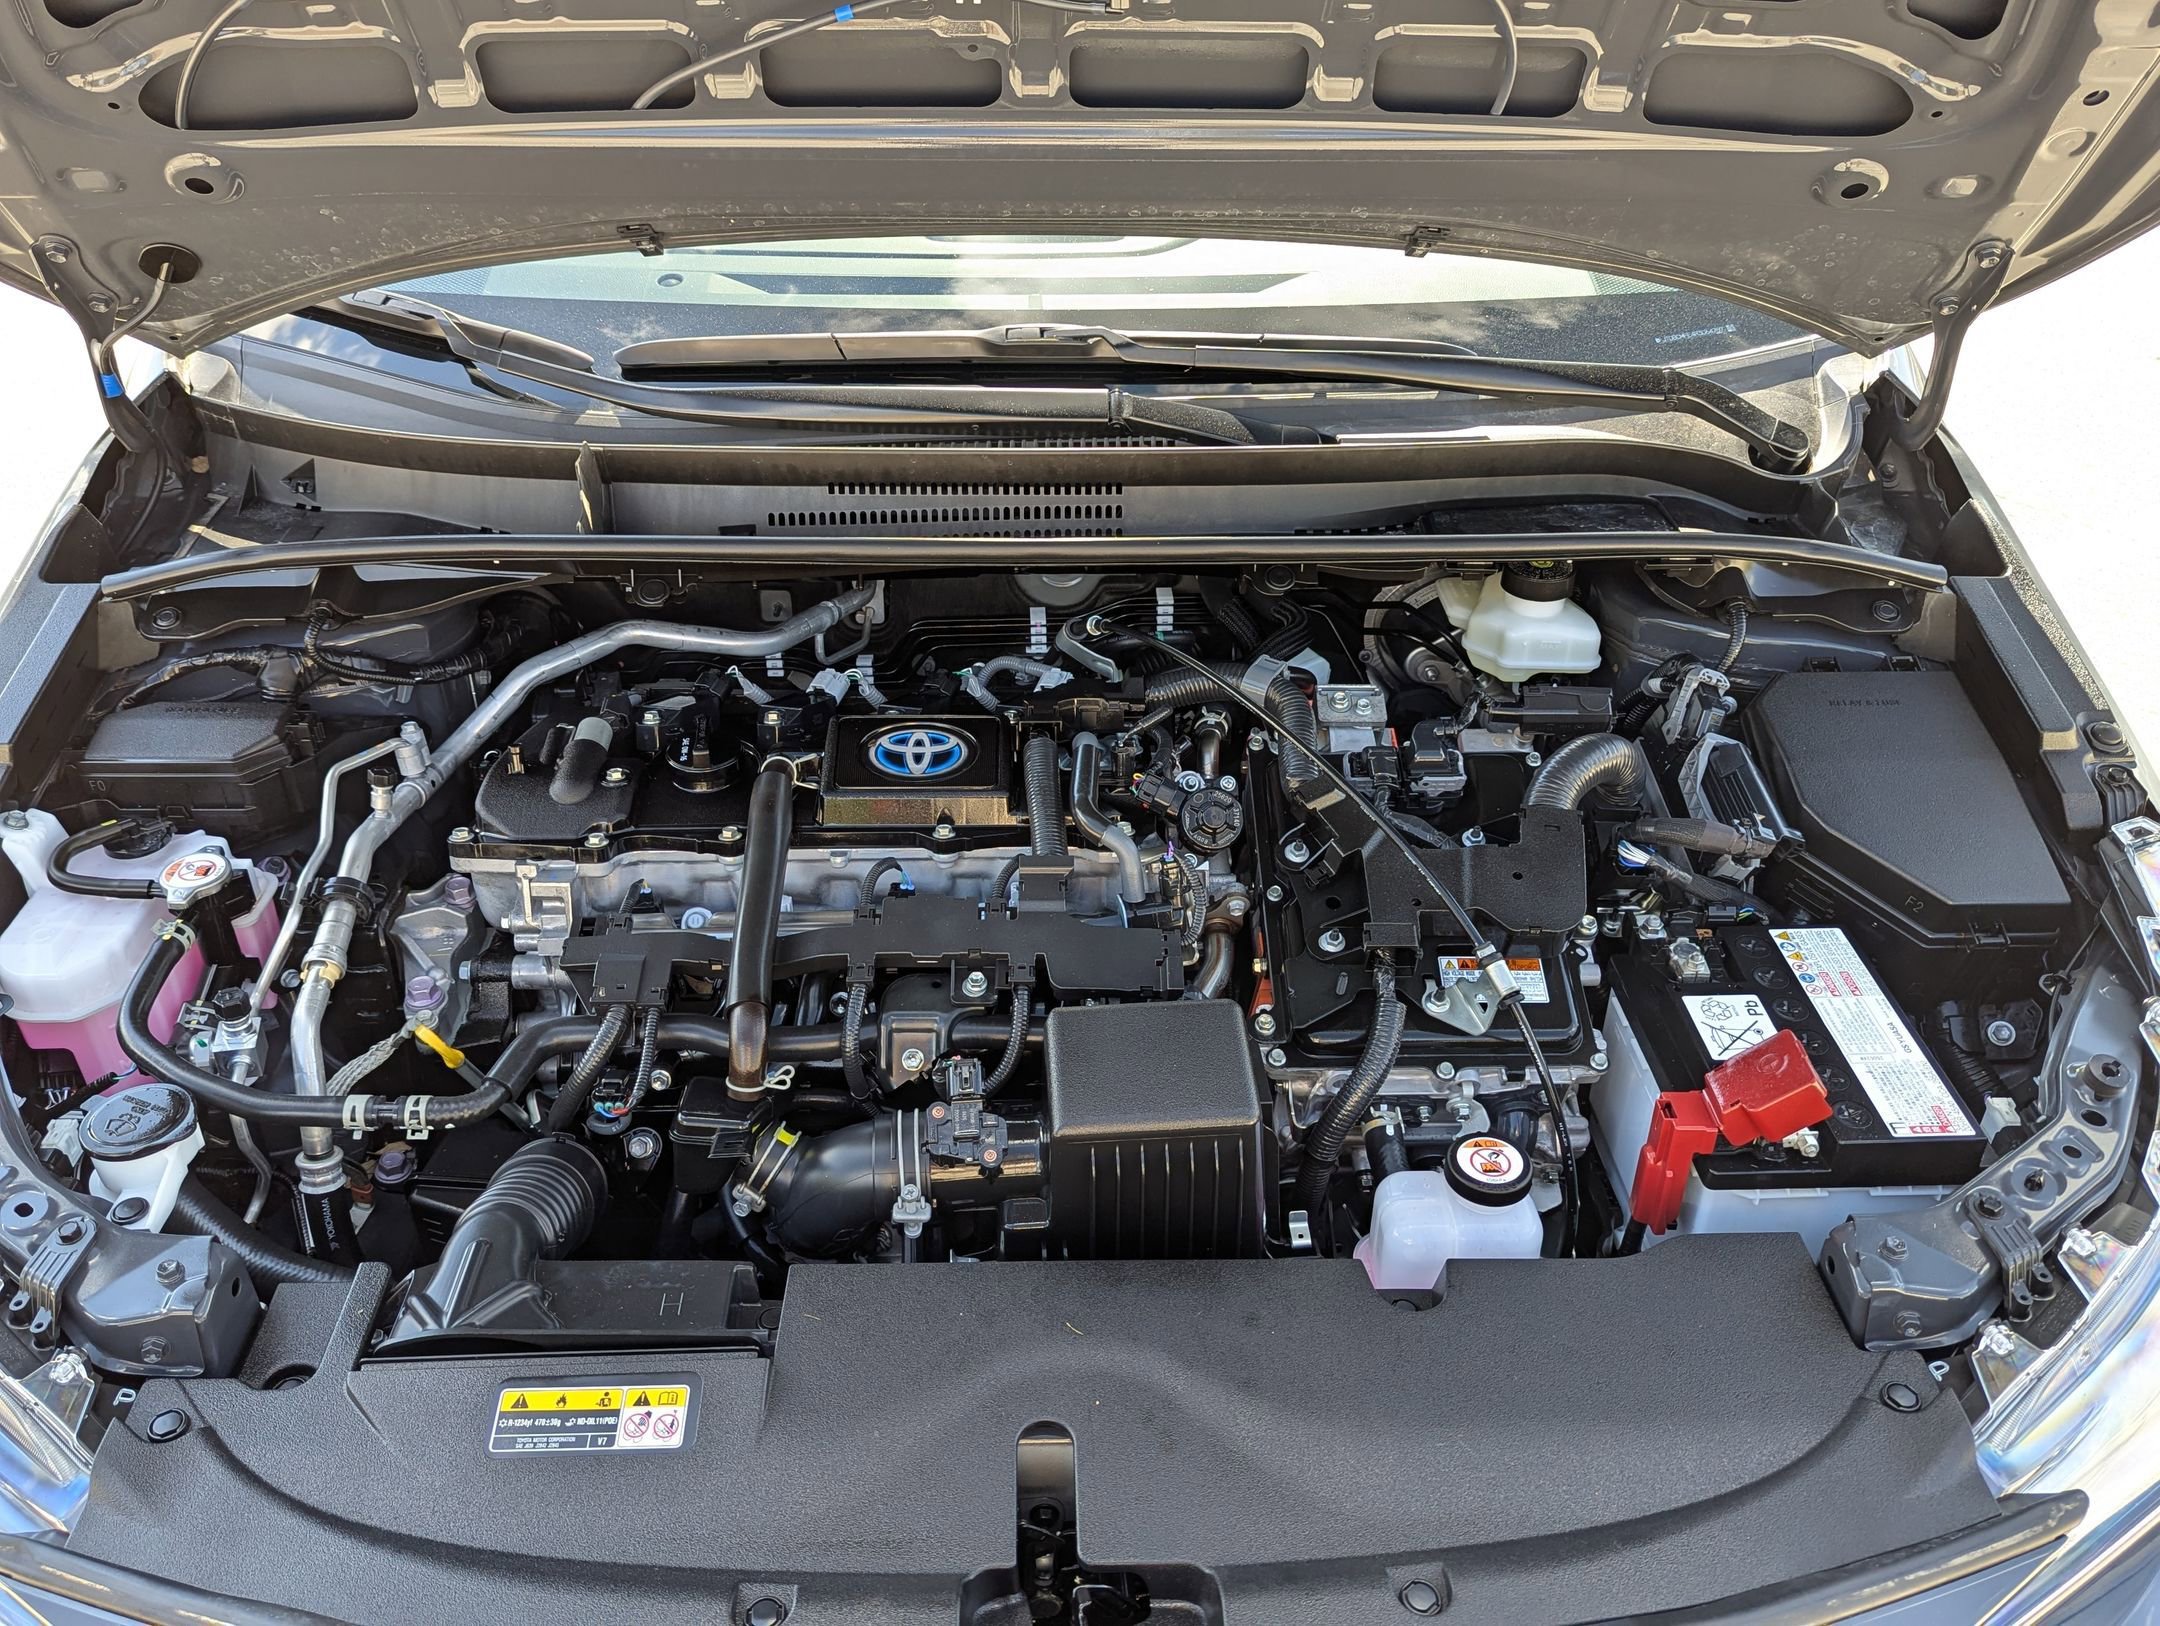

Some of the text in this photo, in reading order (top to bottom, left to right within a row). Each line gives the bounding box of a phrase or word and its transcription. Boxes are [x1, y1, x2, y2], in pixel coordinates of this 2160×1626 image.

[1214, 790, 1232, 804] 25620
[1233, 808, 1241, 827] 37140
[1904, 895, 1924, 913] F2
[1744, 1000, 1764, 1016] Pb
[1886, 1021, 1913, 1053] GS YUASA
[321, 1198, 336, 1239] YOKOHAMA
[660, 1292, 684, 1316] H
[507, 1418, 533, 1428] R-1234yf
[597, 1436, 608, 1446] V7
